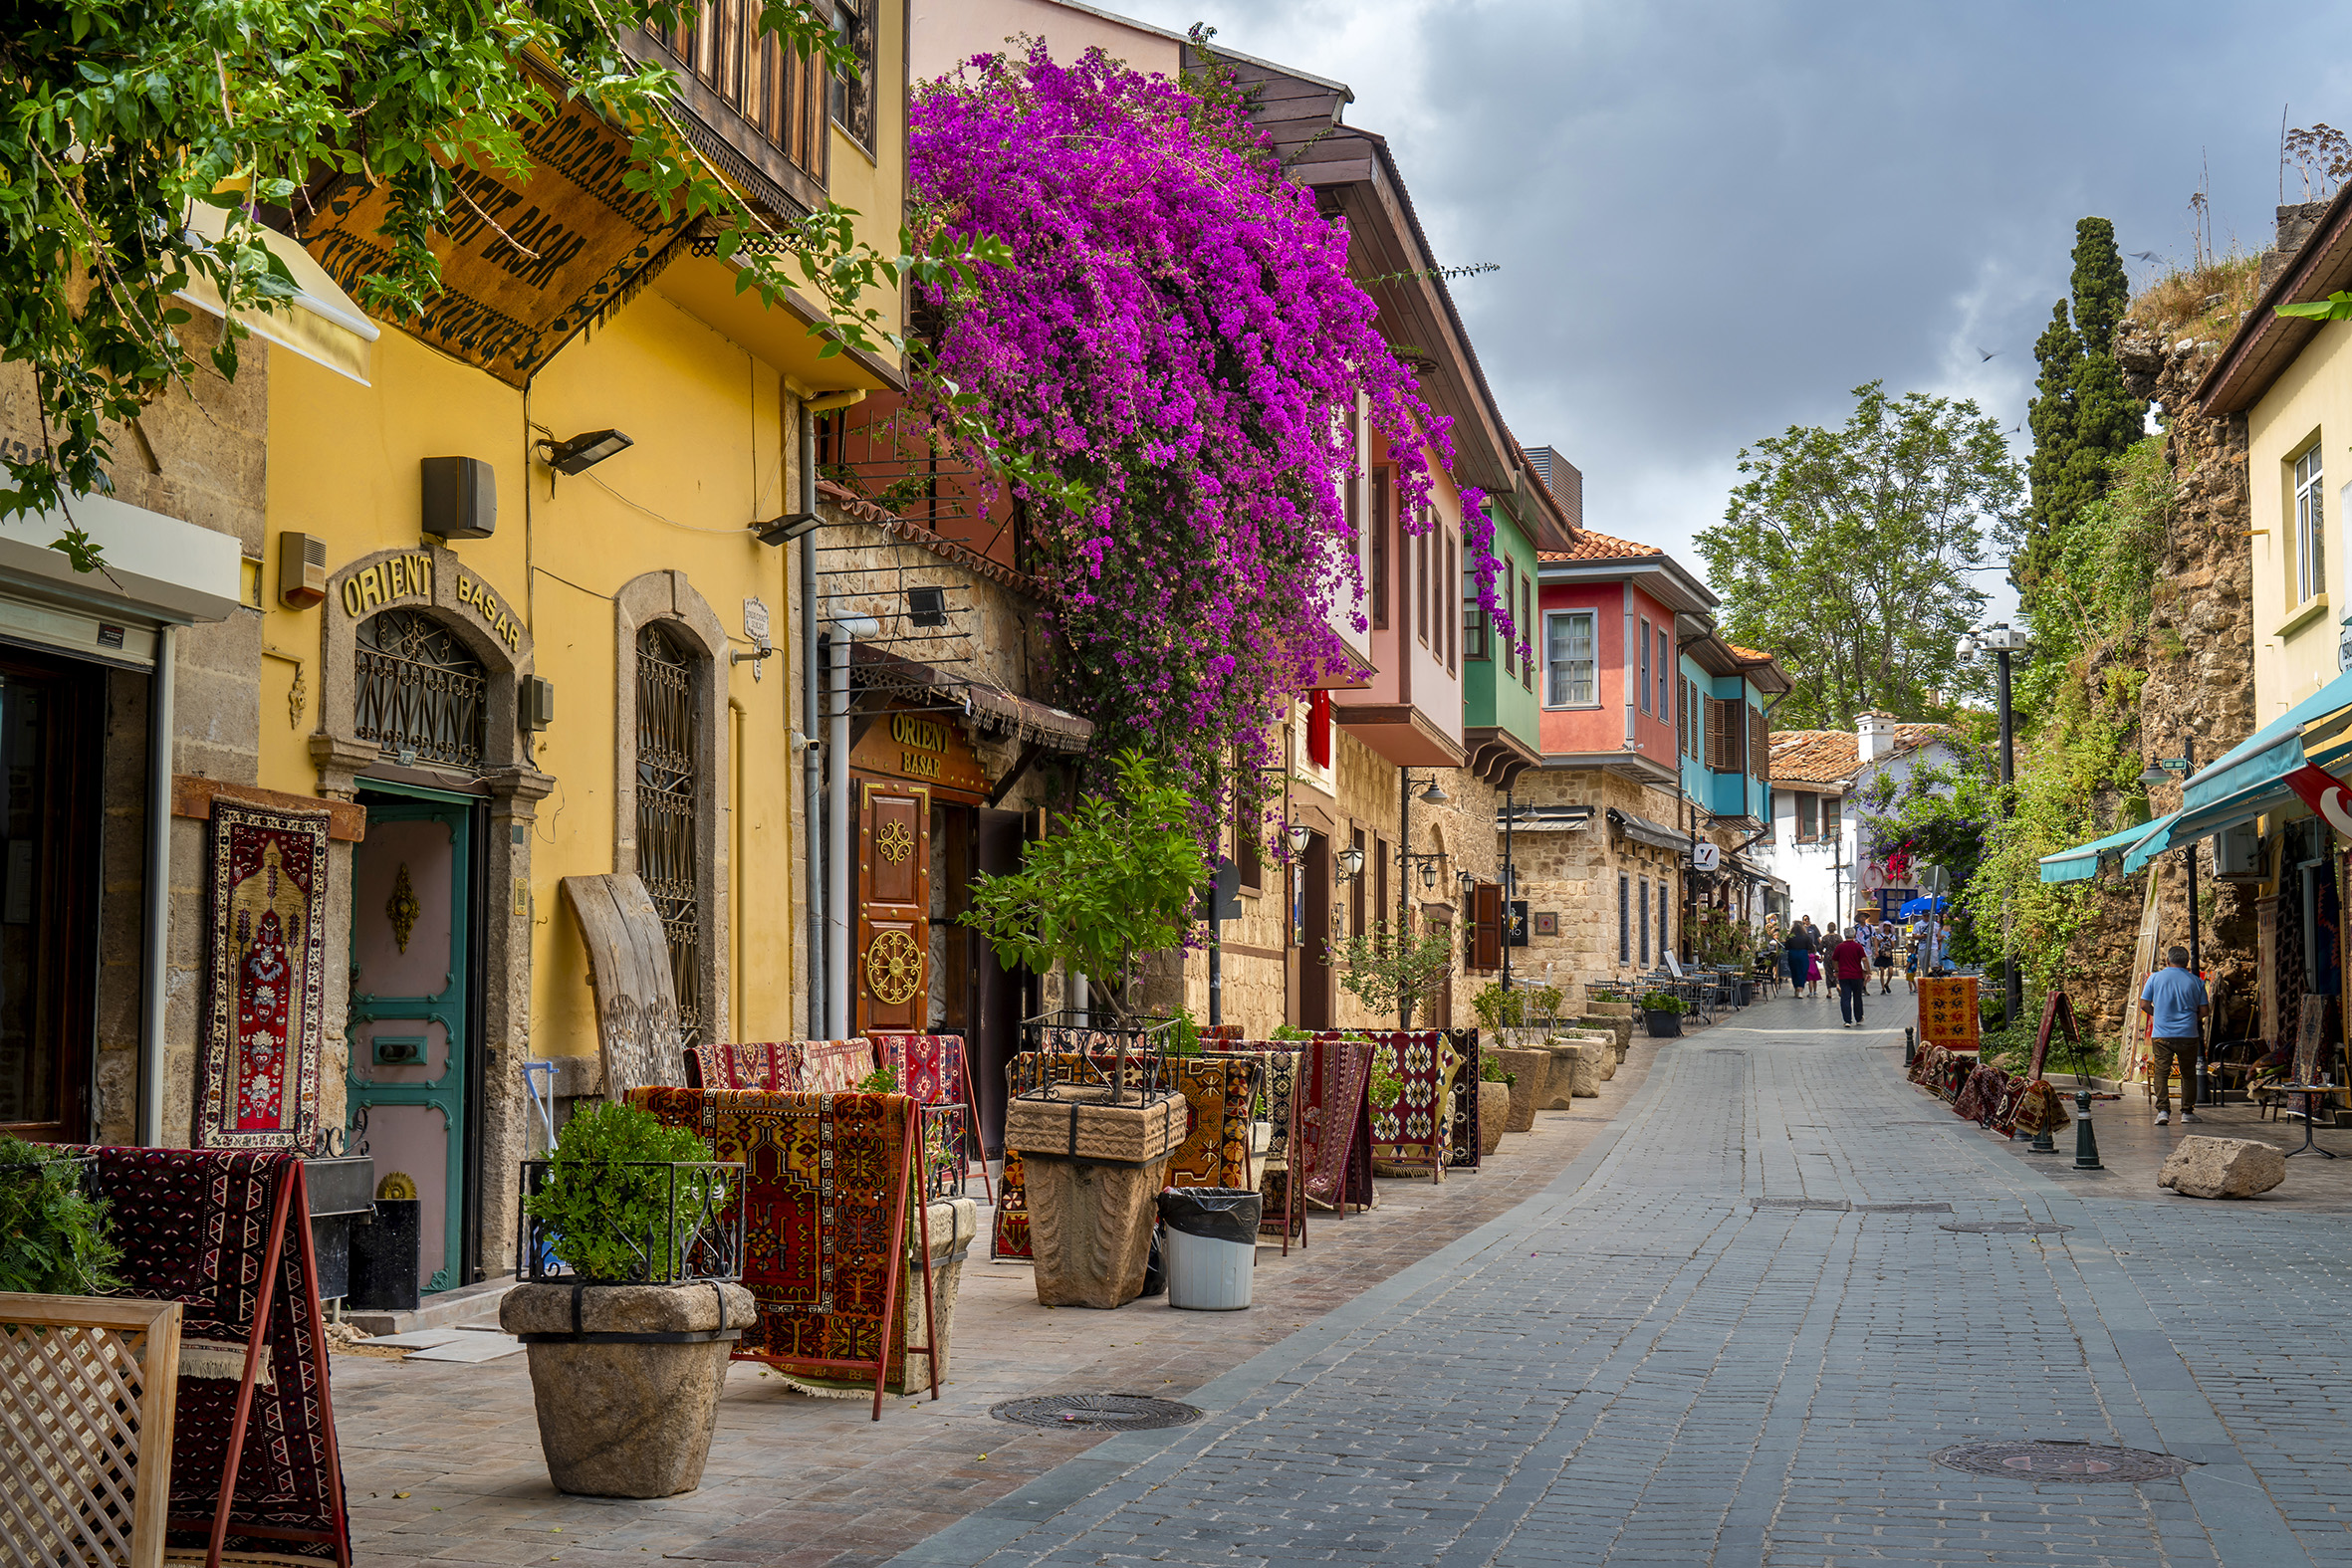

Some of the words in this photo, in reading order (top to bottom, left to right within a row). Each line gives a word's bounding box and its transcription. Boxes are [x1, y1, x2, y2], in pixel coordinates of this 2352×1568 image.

[480, 205, 587, 291] BASAR
[343, 555, 433, 617] ORIENT
[457, 574, 520, 653] BASAR
[892, 712, 952, 755] ORIENT
[903, 752, 941, 779] BASAR
